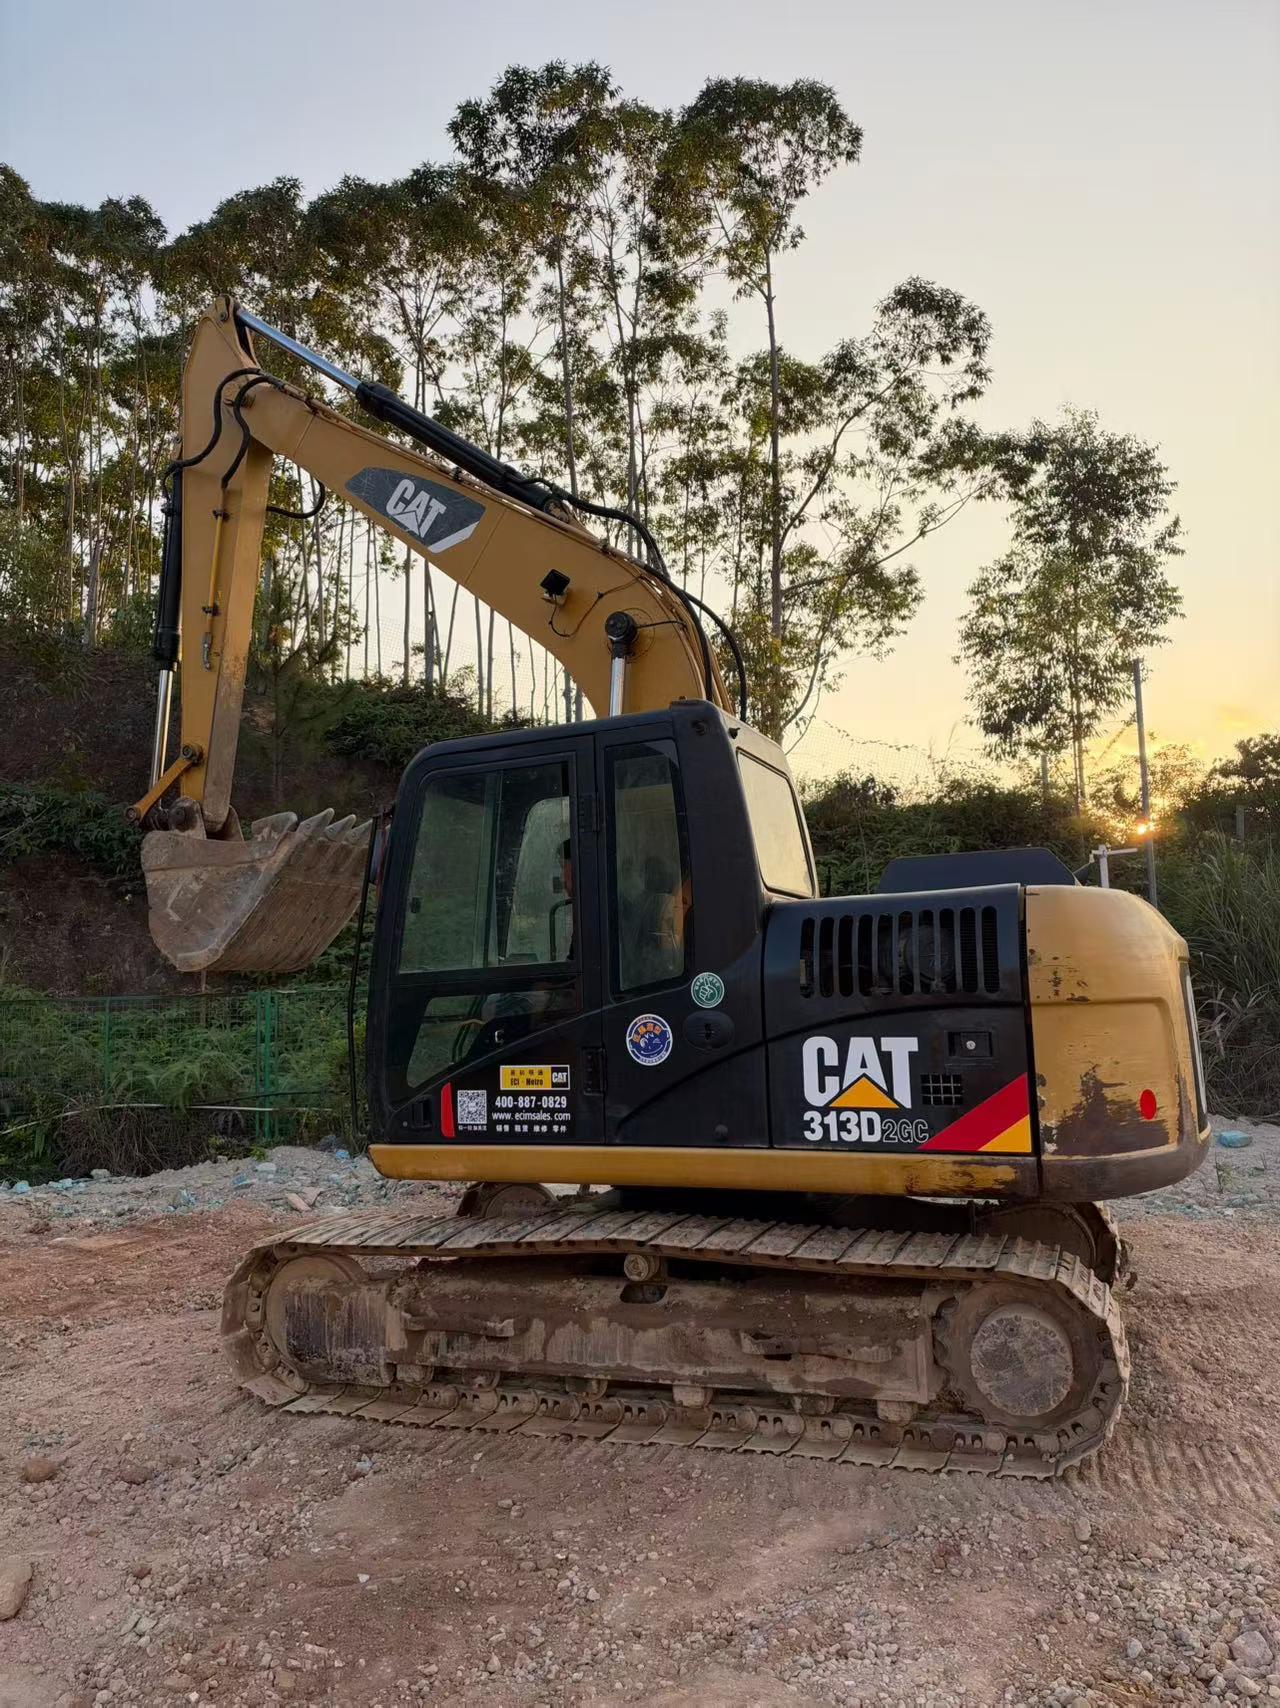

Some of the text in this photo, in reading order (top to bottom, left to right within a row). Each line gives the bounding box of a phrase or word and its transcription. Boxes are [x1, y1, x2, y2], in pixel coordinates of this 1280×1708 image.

[386, 479, 447, 538] CAT
[552, 1072, 568, 1083] CAT
[803, 1036, 919, 1109] CAT
[526, 1078, 544, 1086] Metro
[495, 1096, 567, 1109] 400-887-0829
